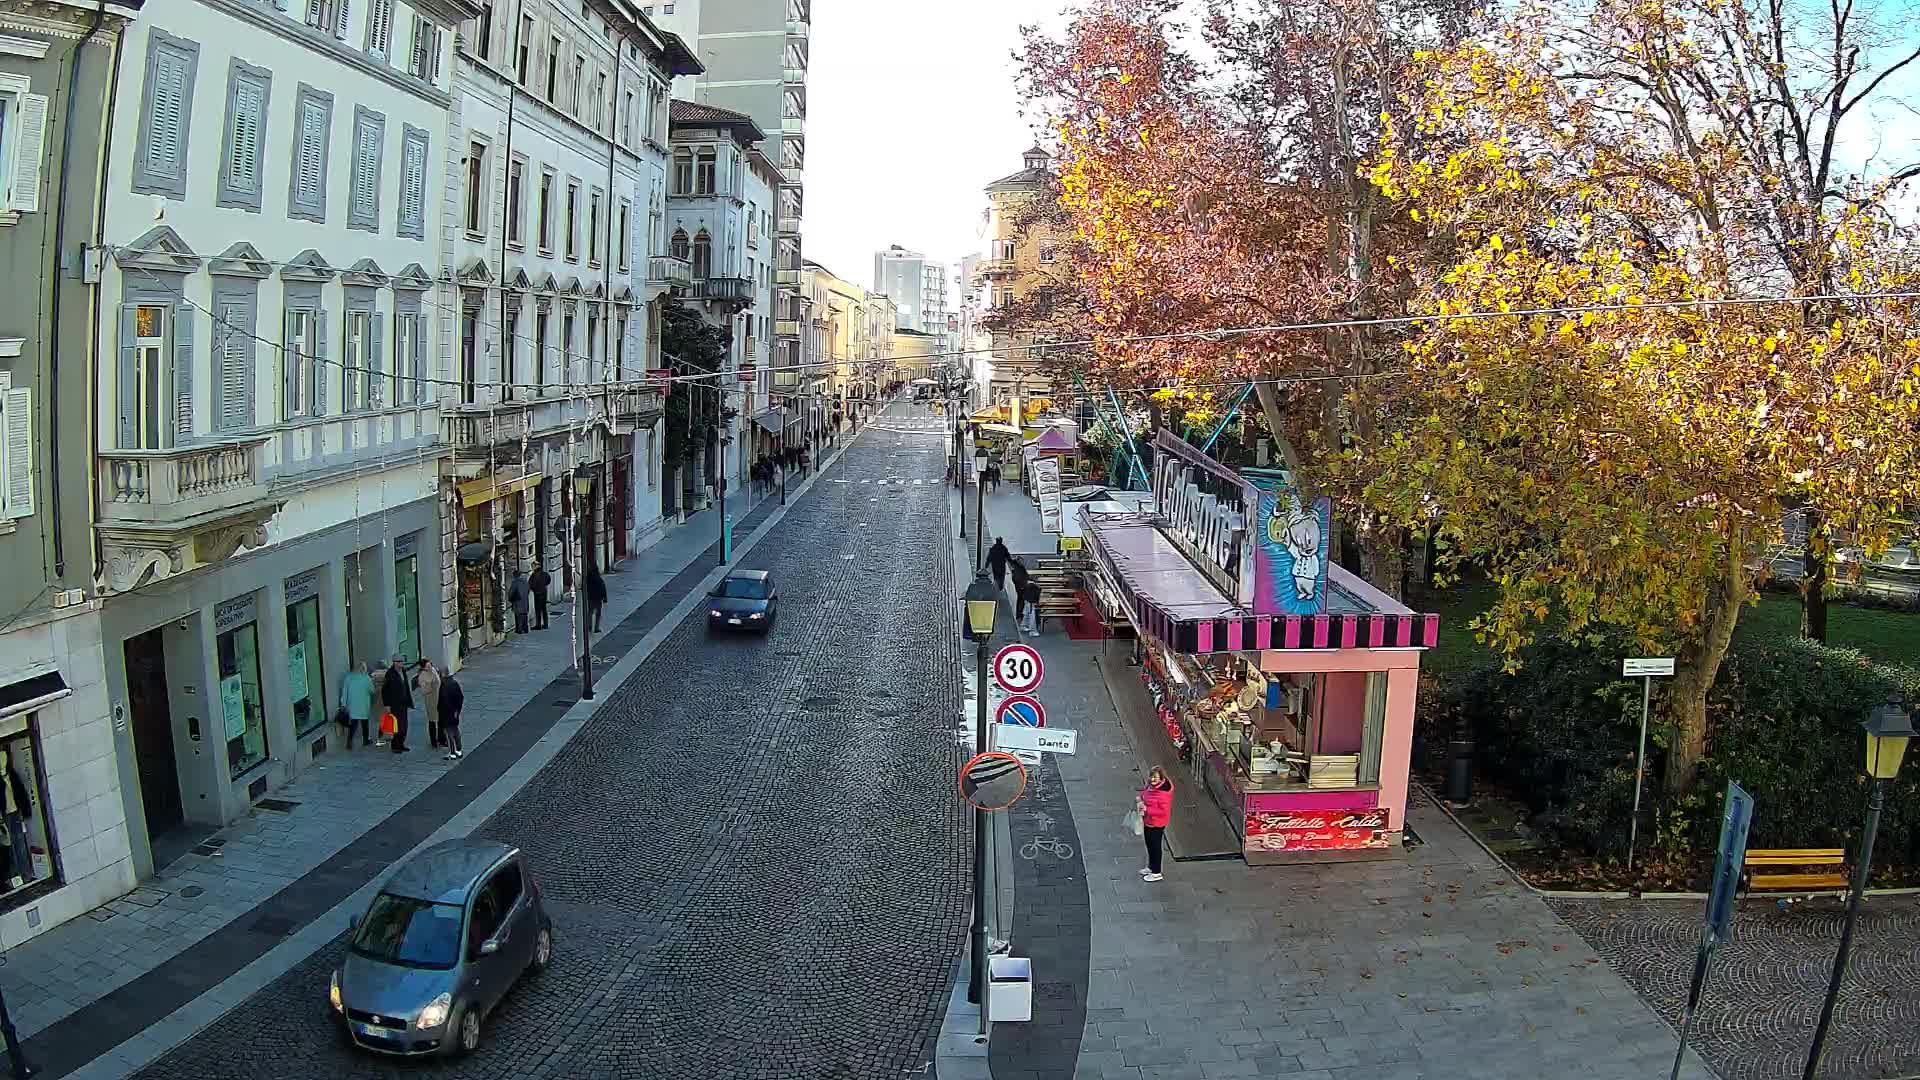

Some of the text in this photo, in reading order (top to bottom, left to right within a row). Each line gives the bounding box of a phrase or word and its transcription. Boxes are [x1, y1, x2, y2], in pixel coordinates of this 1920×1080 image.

[1006, 658, 1032, 679] 30
[1038, 737, 1069, 749] Dante
[1331, 814, 1382, 828] Calde
